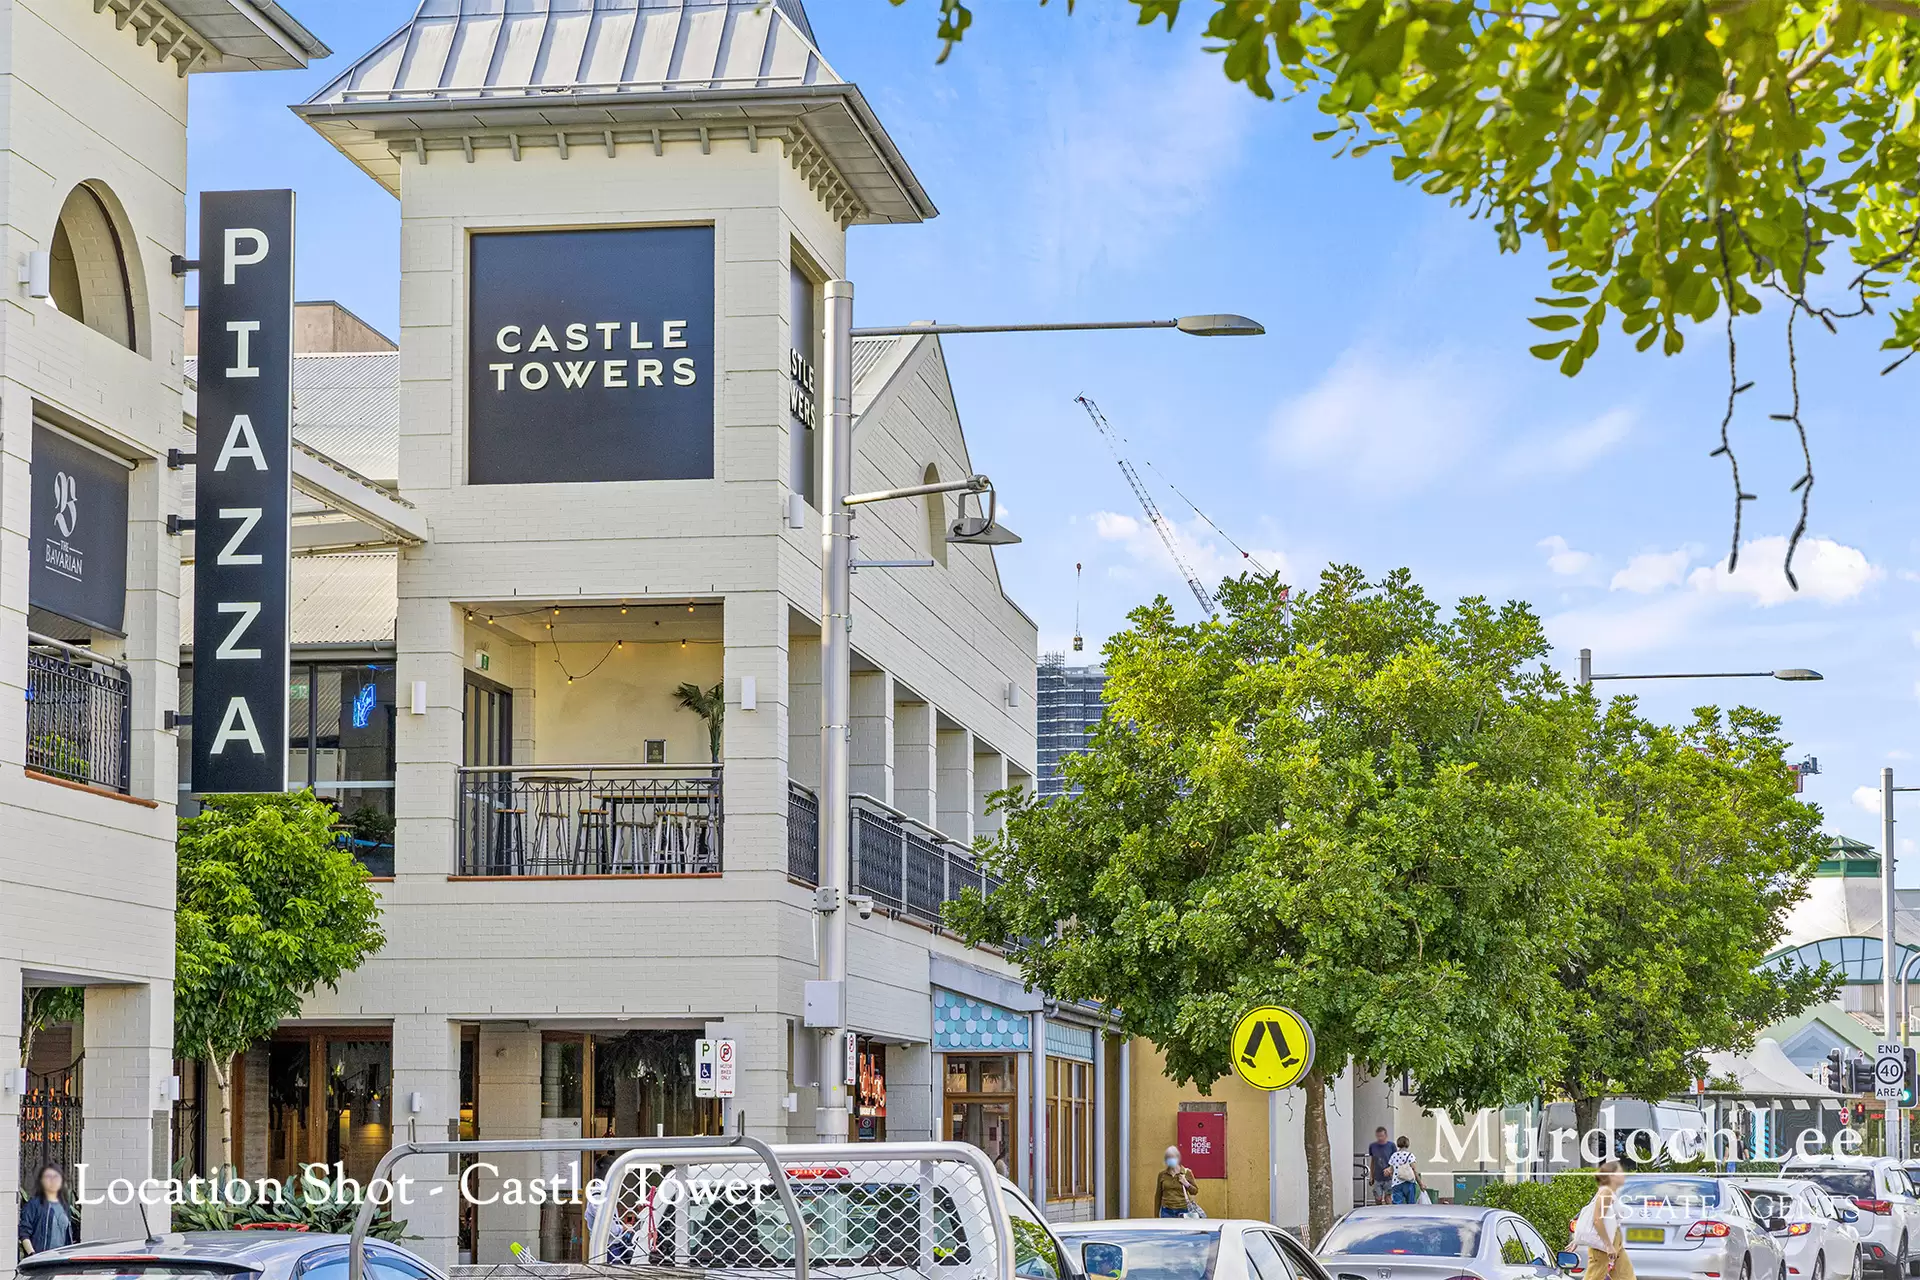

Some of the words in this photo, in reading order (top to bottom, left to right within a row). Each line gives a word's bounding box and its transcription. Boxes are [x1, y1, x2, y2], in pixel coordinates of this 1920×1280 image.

[496, 320, 687, 353] CASTLE
[489, 358, 697, 390] TOWERS
[790, 347, 814, 394] STLE
[789, 381, 816, 430] WERS
[209, 228, 270, 755] PIAZZA
[45, 544, 83, 575] BAVARIAN
[60, 540, 69, 552] THE
[702, 1043, 710, 1056] P
[1878, 1045, 1900, 1053] END
[1880, 1064, 1899, 1077] 40
[1876, 1088, 1904, 1097] AREA
